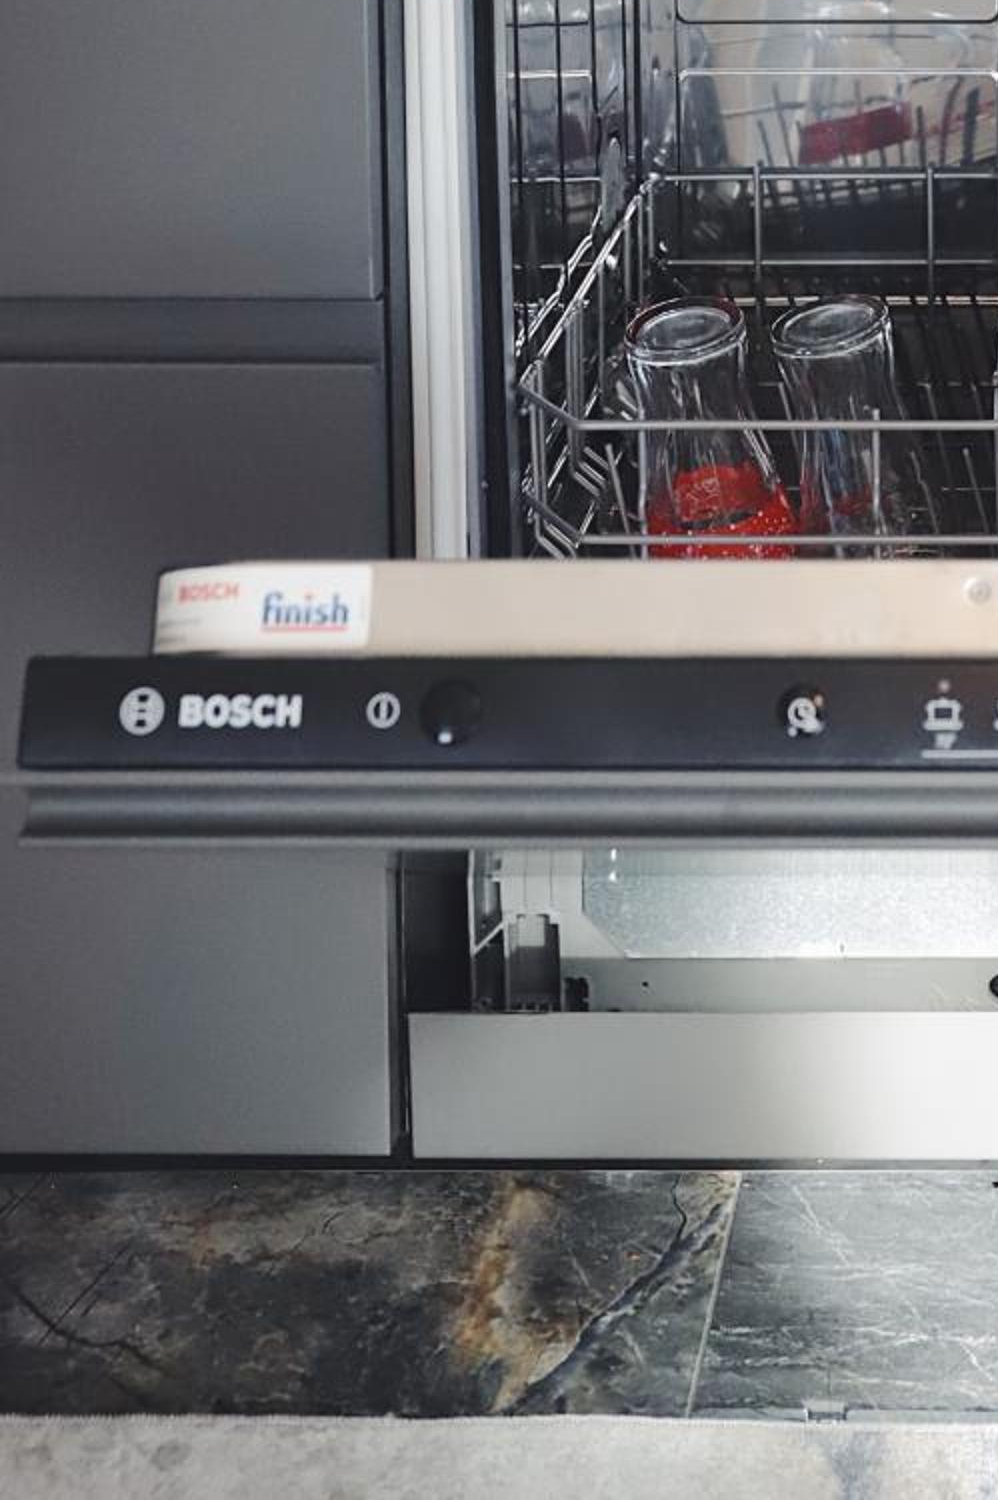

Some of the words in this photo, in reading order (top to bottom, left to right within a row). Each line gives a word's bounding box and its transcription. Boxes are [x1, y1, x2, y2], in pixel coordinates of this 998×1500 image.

[177, 583, 240, 604] BOSCH
[262, 591, 349, 625] finish
[178, 693, 303, 729] BOSCH
